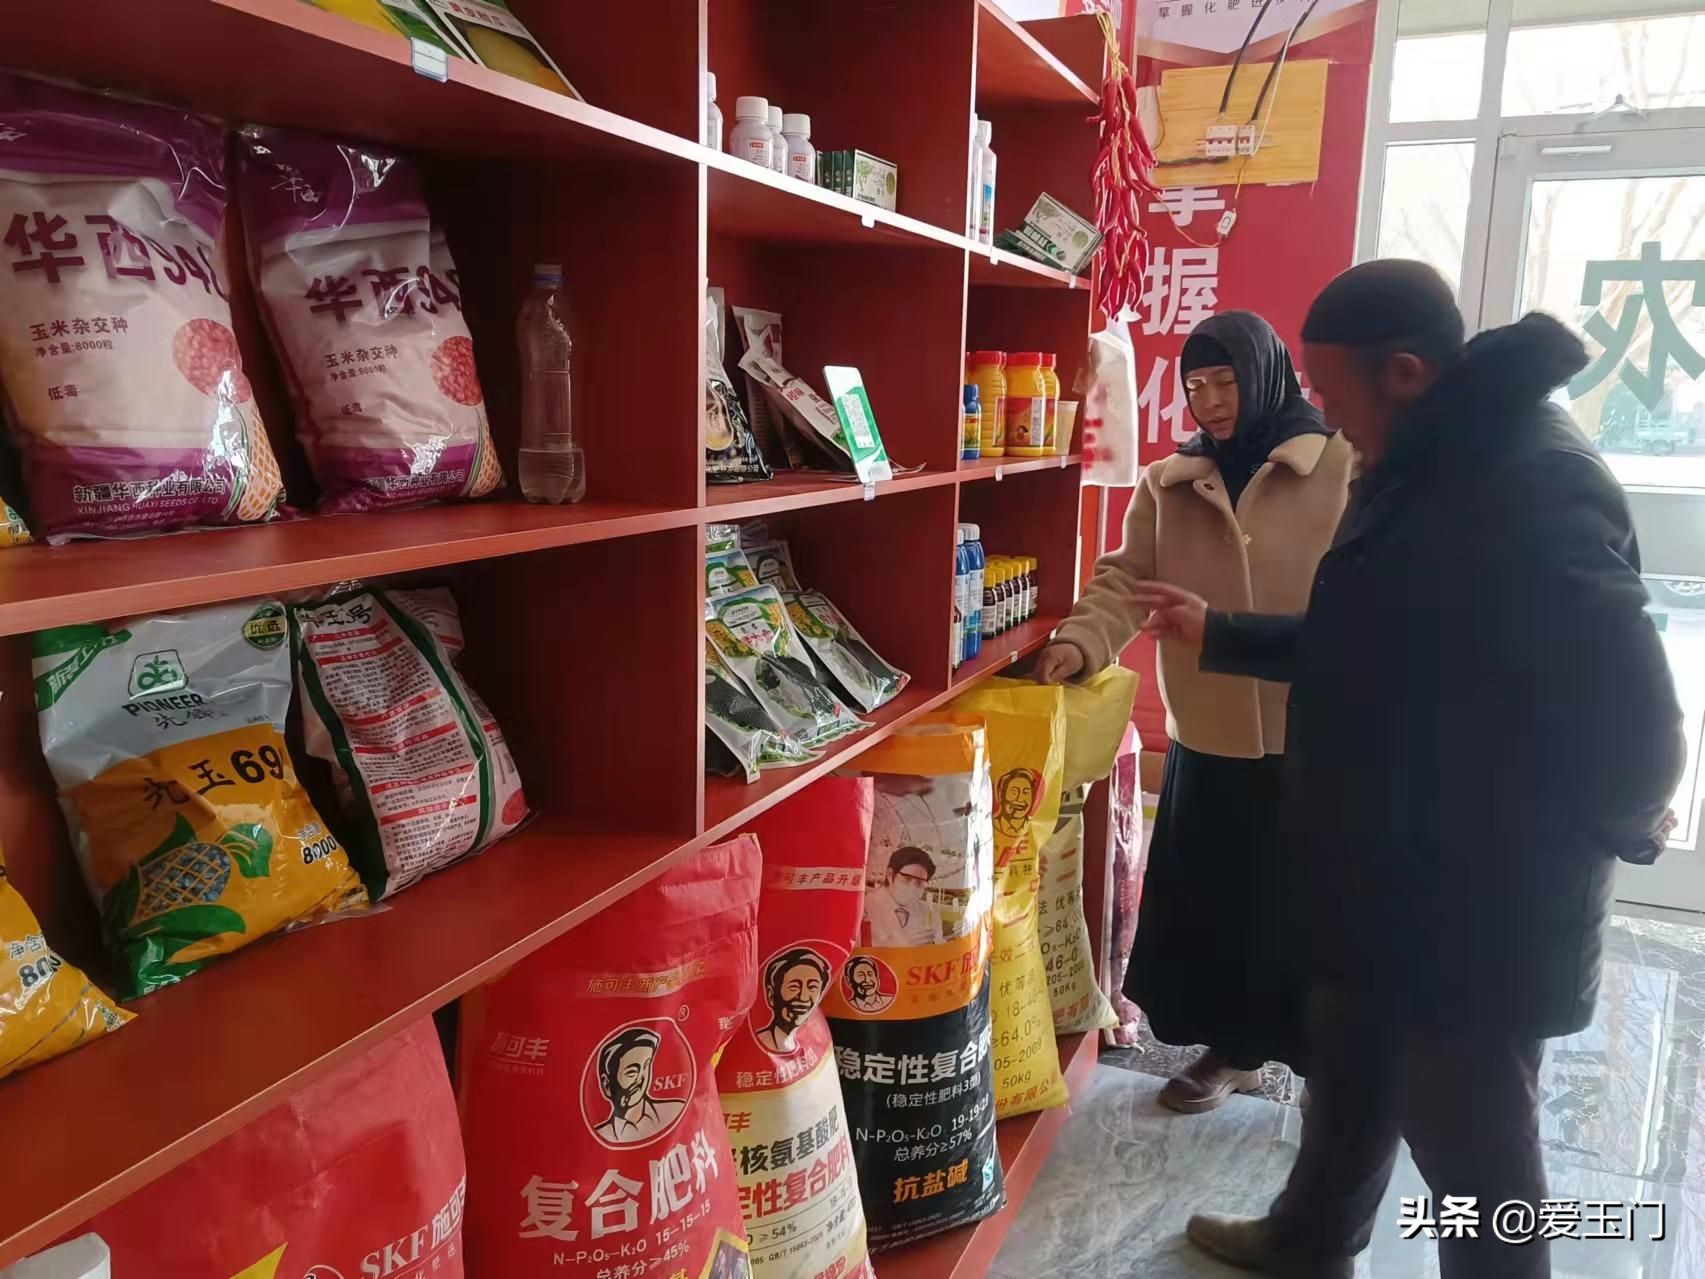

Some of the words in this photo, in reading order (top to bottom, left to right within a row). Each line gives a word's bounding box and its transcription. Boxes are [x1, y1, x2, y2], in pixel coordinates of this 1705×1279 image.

[29, 316, 129, 342] 玉米杂交种
[324, 344, 399, 369] 玉米杂交种
[48, 383, 80, 401] 低毒
[73, 478, 226, 503] 新疆华西种业有限公司
[76, 501, 131, 515] XINJIANG
[159, 496, 188, 508] SEEDS
[121, 693, 204, 717] PIONEER
[653, 1071, 690, 1092] SKF
[733, 1104, 839, 1176] 核氨基酸肥
[518, 1131, 720, 1242] 复合肥料
[893, 1158, 969, 1203] 抗盐碱
